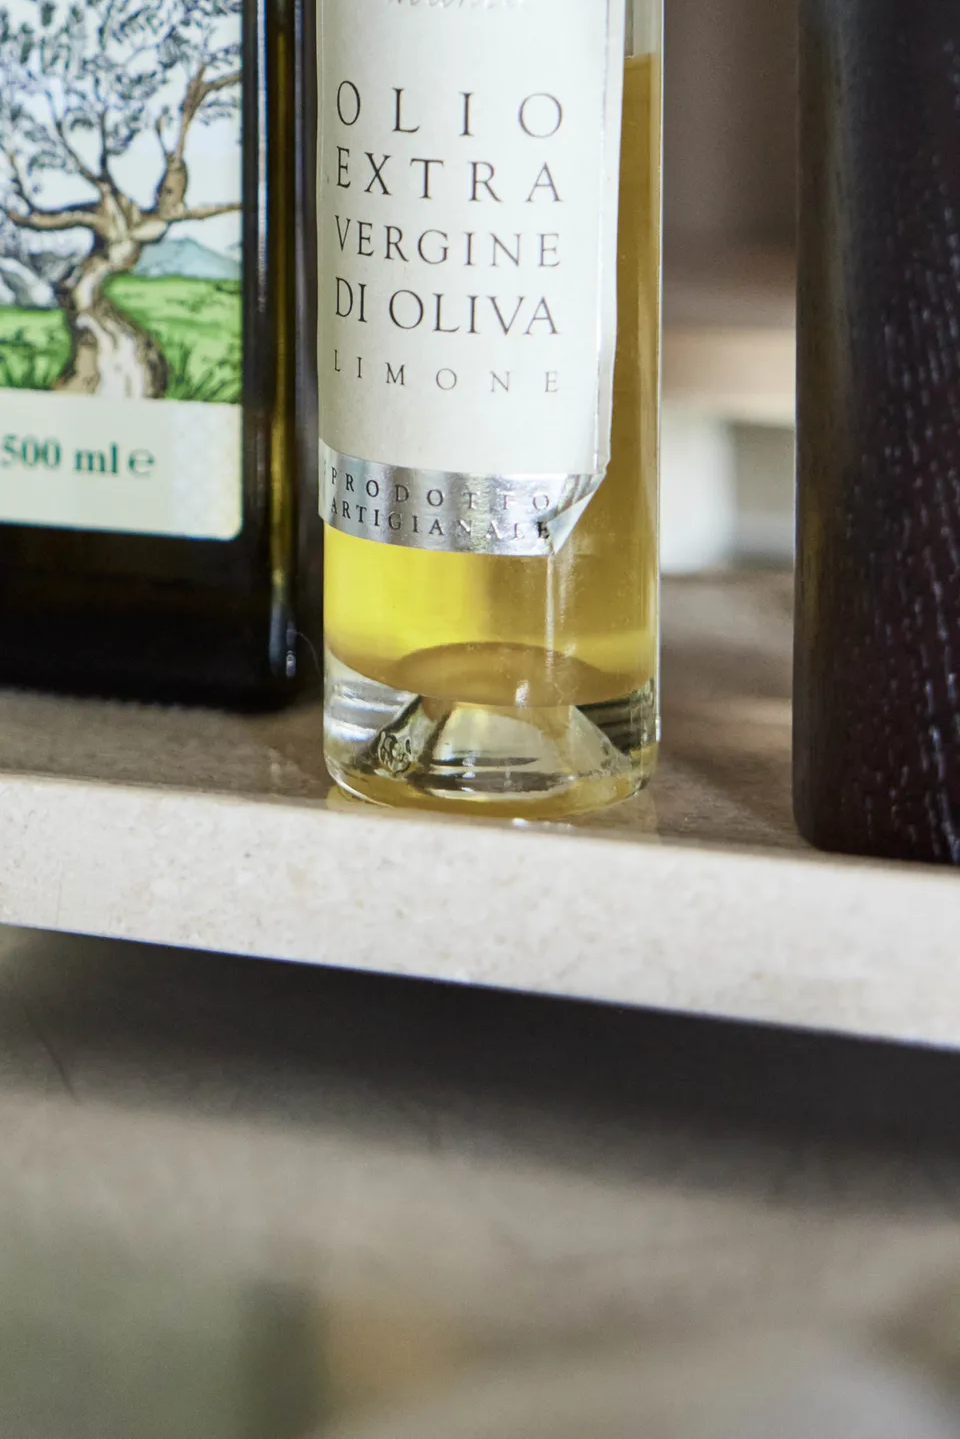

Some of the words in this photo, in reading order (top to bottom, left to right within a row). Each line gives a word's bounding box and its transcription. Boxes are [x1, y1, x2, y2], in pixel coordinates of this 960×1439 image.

[337, 80, 563, 138] OLIO
[336, 146, 563, 203] EXTRA
[335, 215, 561, 267] VERGINE
[336, 277, 367, 322] DI
[389, 290, 560, 335] OLIVA
[334, 349, 559, 393] LIMONE
[1, 434, 62, 467] 500
[74, 442, 118, 475] ml
[331, 466, 550, 510] PRODOTTO
[331, 497, 550, 540] ARTIGIANALE
